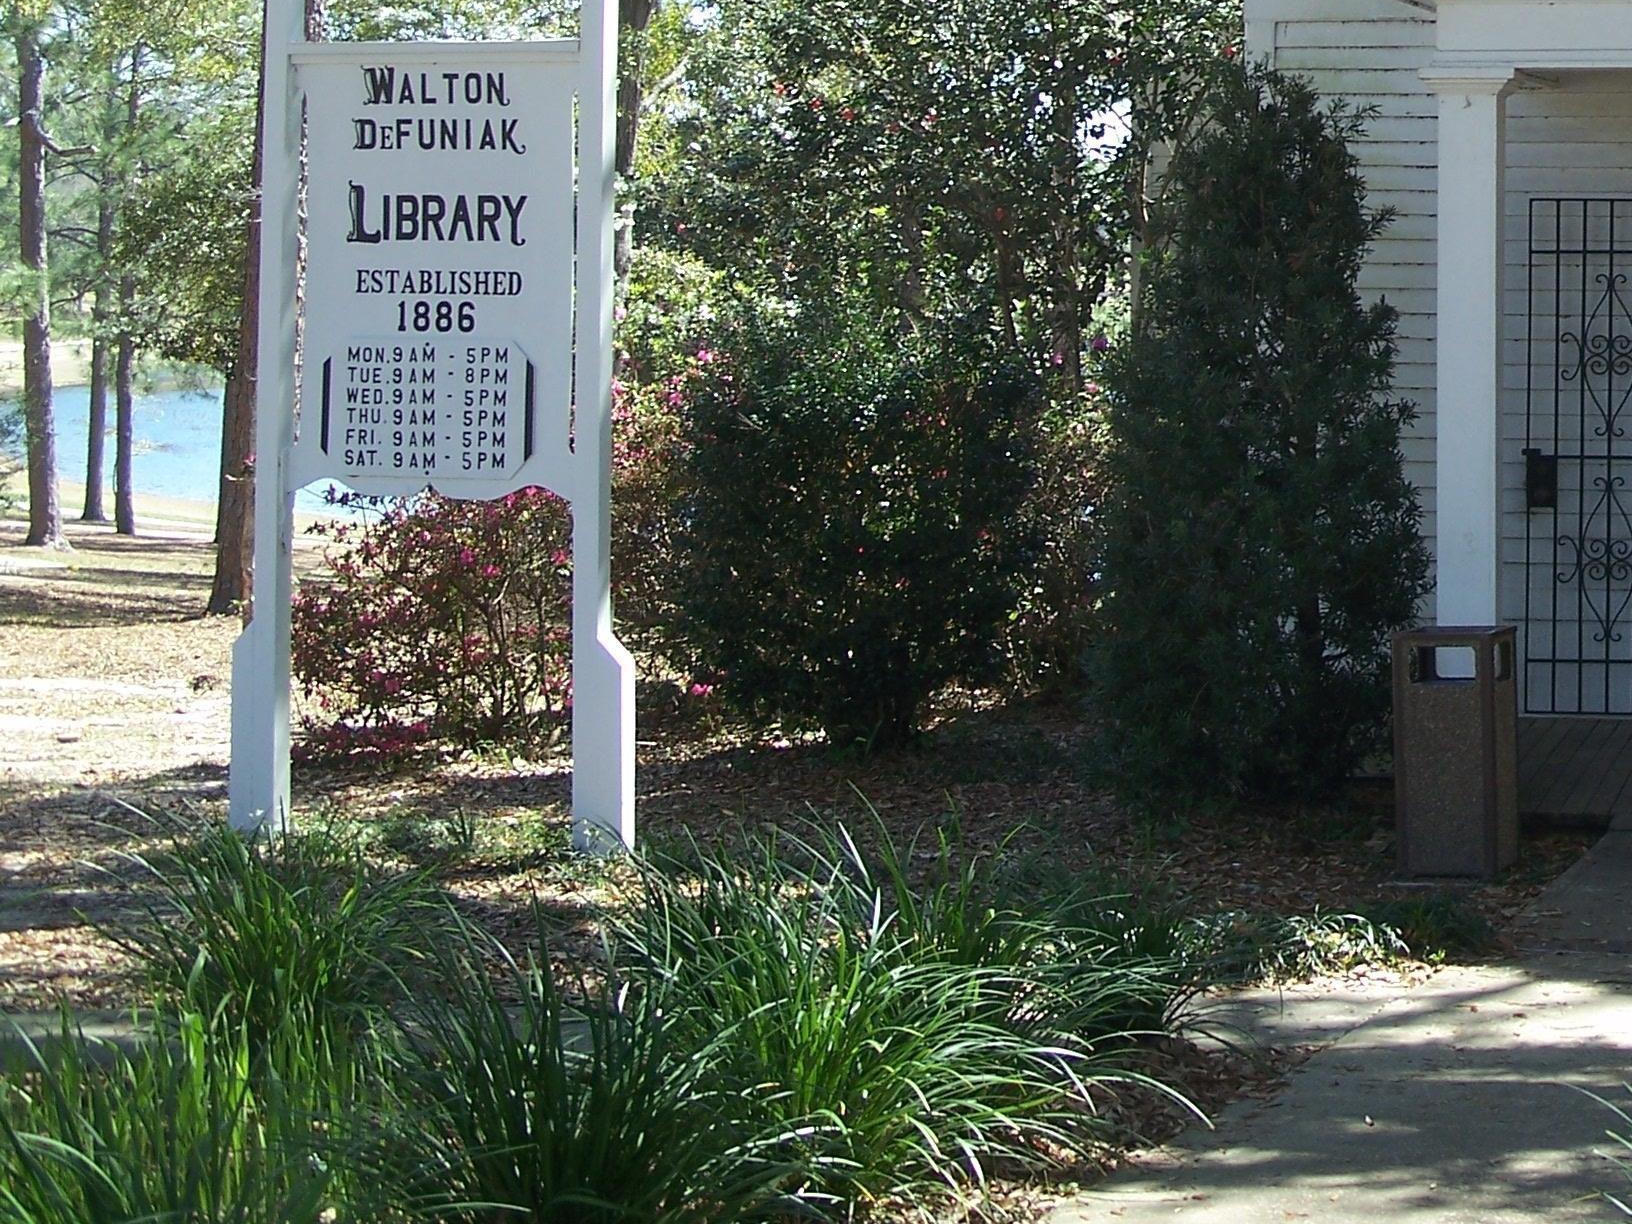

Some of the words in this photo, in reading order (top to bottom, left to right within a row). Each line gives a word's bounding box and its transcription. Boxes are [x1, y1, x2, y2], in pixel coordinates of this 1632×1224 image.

[361, 65, 510, 106] WALTON
[347, 180, 527, 246] LIBRARY
[356, 270, 522, 295] ESTABLISHED
[398, 301, 475, 332] 1886
[348, 347, 390, 364] MON.
[467, 347, 508, 364] 5PM
[348, 367, 389, 384] TUE.
[465, 368, 507, 384] 8PM
[347, 387, 389, 405] WED.
[464, 389, 506, 407] 5PM
[346, 408, 387, 424] THU.
[463, 410, 505, 427] 5PM
[346, 429, 381, 445] FRI.
[462, 431, 505, 448] 5PM
[345, 449, 382, 466] SAT.
[462, 452, 505, 470] 5PM
